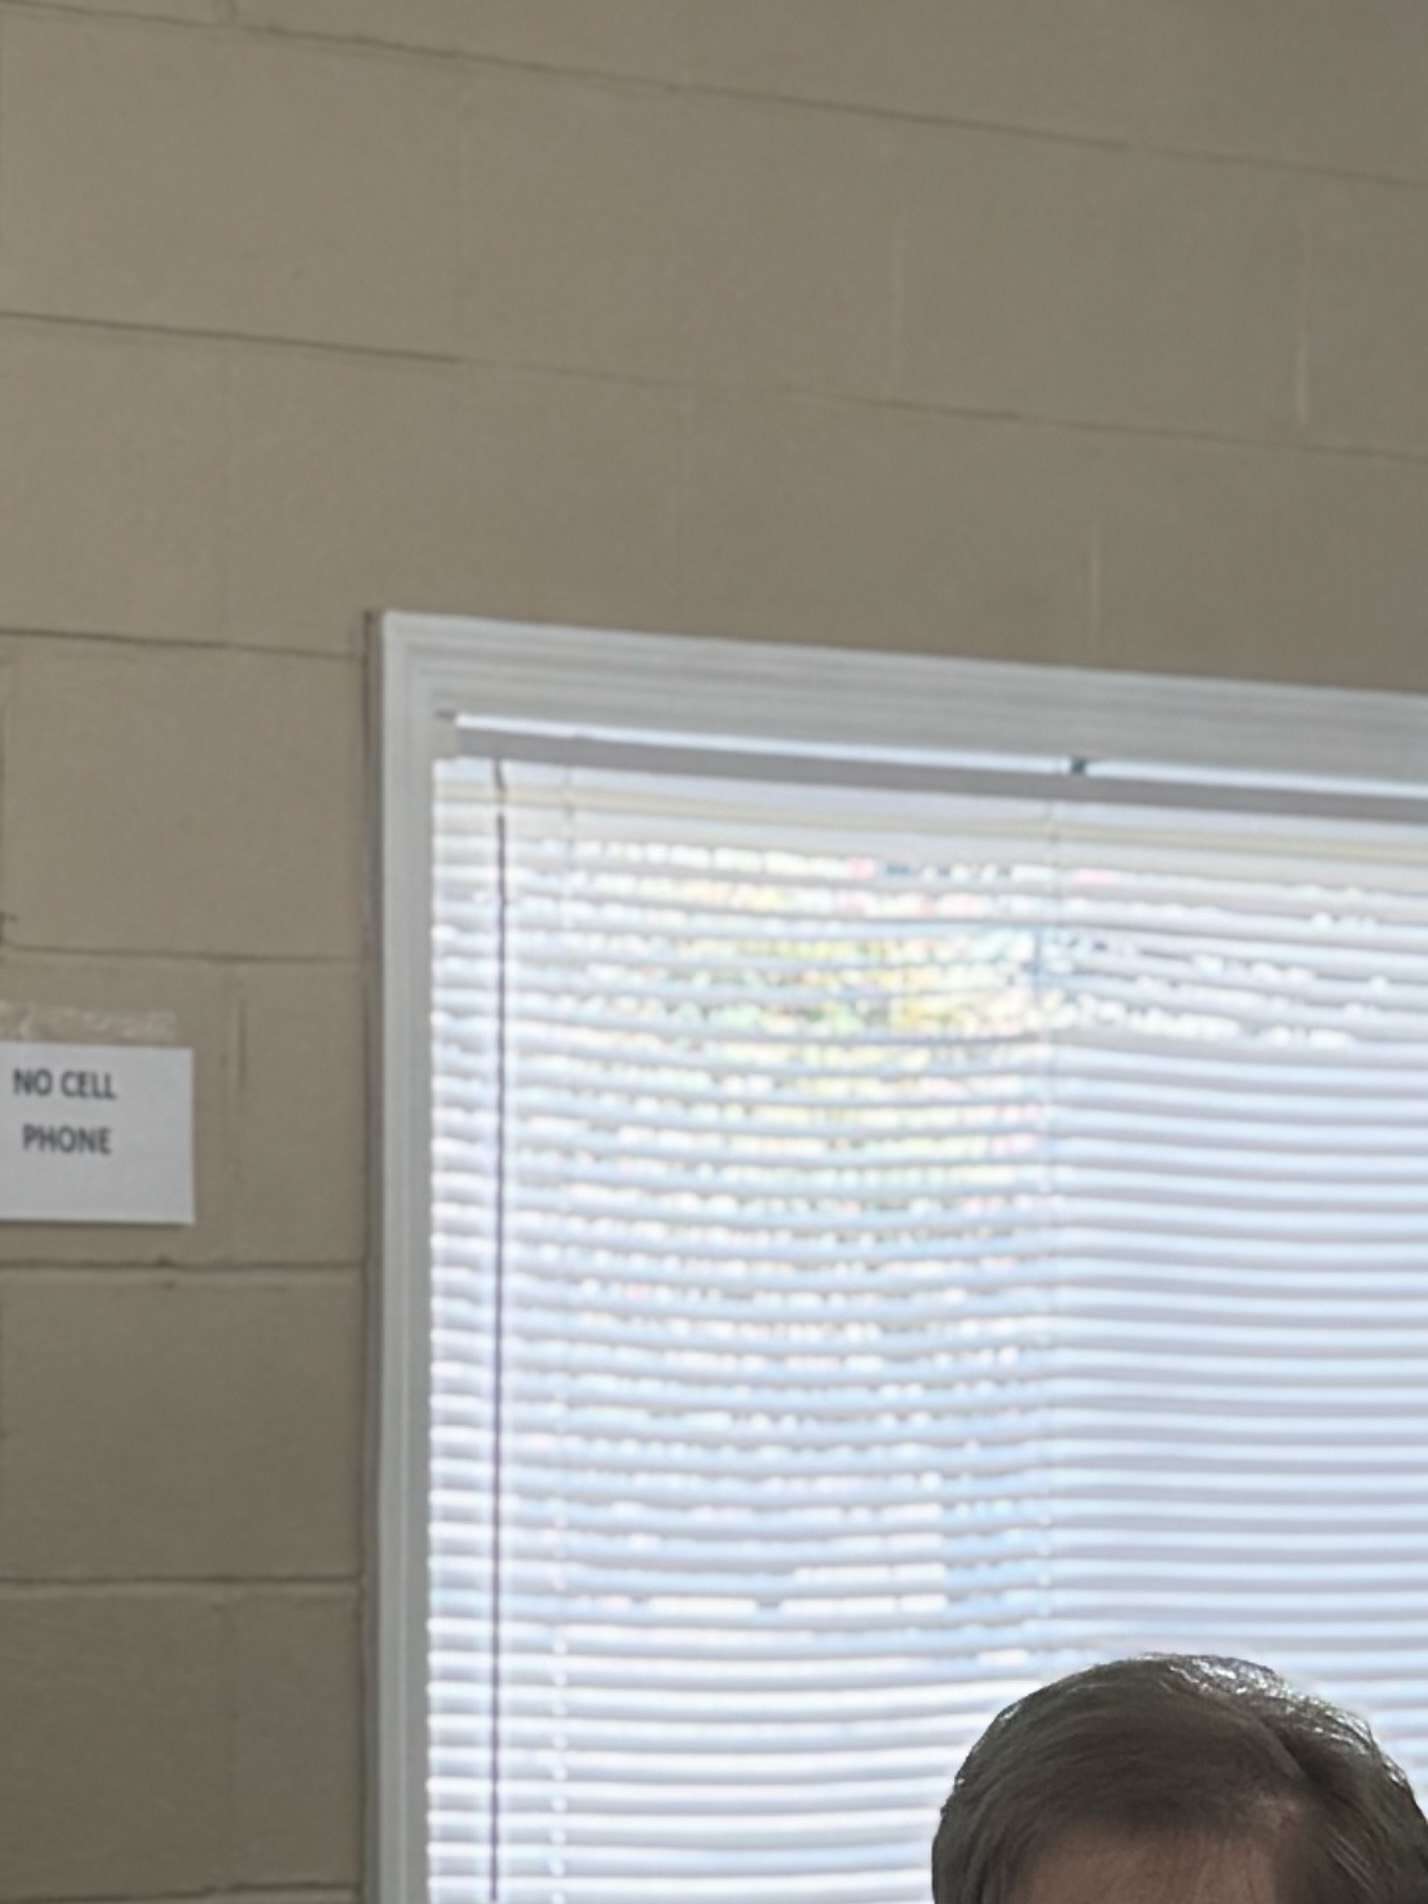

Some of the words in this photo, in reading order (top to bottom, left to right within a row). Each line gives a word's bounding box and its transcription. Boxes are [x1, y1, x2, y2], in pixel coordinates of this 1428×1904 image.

[13, 1068, 53, 1096] NO
[61, 1070, 117, 1100] CELL
[22, 1123, 112, 1154] PHONE
